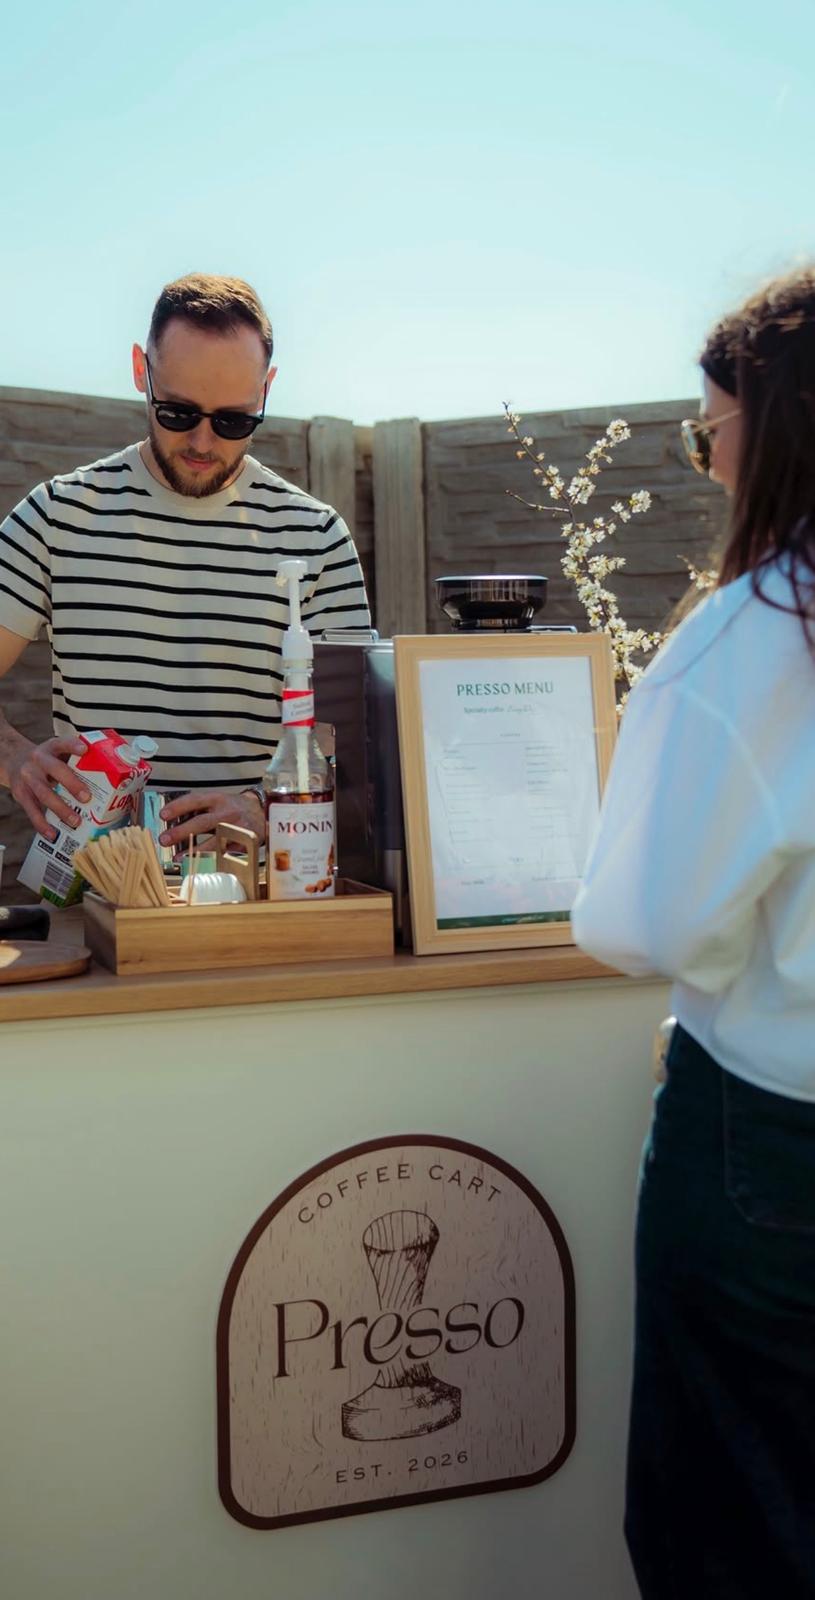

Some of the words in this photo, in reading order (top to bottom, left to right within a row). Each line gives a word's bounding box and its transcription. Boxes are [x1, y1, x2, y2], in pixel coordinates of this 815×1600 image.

[456, 682, 511, 696] PRESSO
[514, 681, 554, 695] MENU
[277, 820, 333, 833] MONIN
[298, 1163, 410, 1223] COFFEE
[429, 1164, 501, 1202] CART
[272, 1297, 525, 1380] Presso
[335, 1464, 392, 1484] EST.
[408, 1451, 469, 1472] 2026
